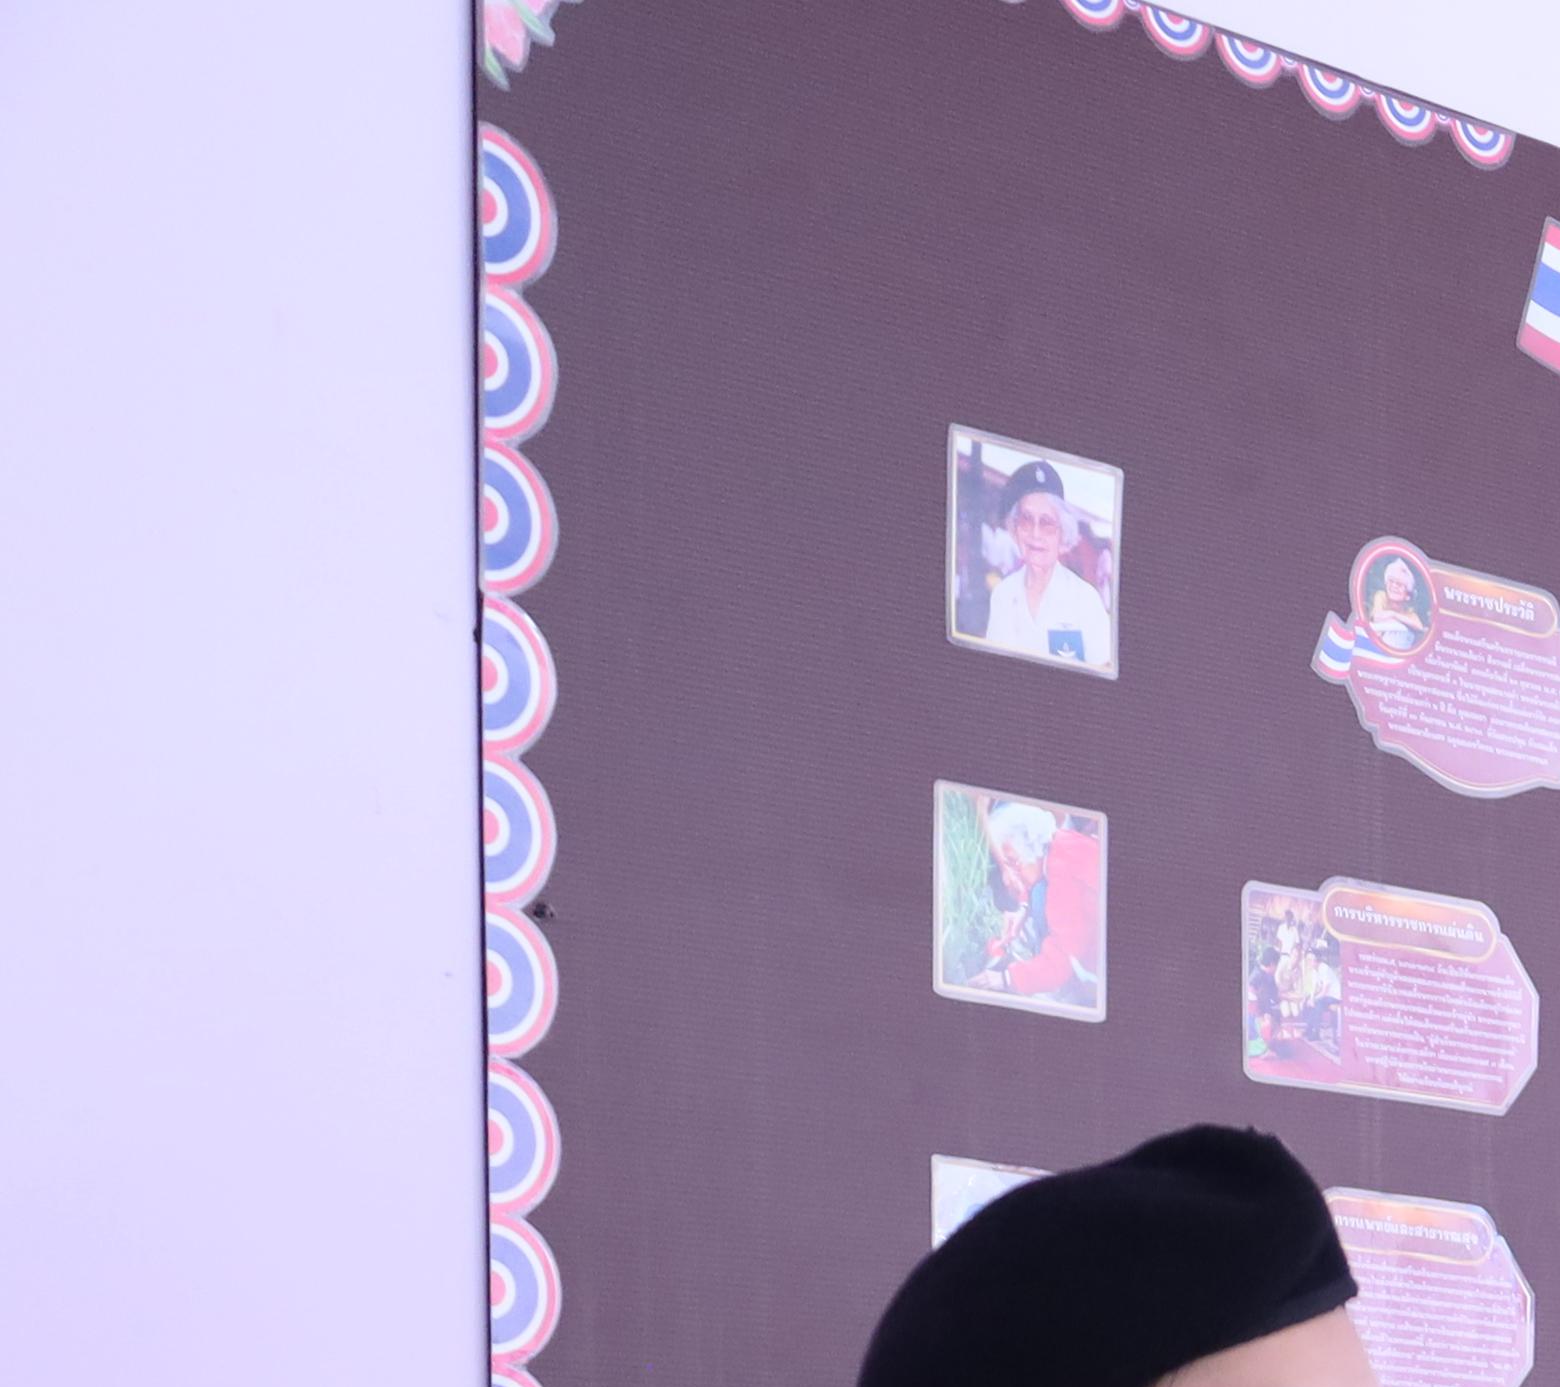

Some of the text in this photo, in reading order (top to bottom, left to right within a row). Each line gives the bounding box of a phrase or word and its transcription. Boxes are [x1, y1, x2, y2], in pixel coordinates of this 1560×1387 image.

[1333, 905, 1485, 943] การบริหารราชการแผ่นดิน
